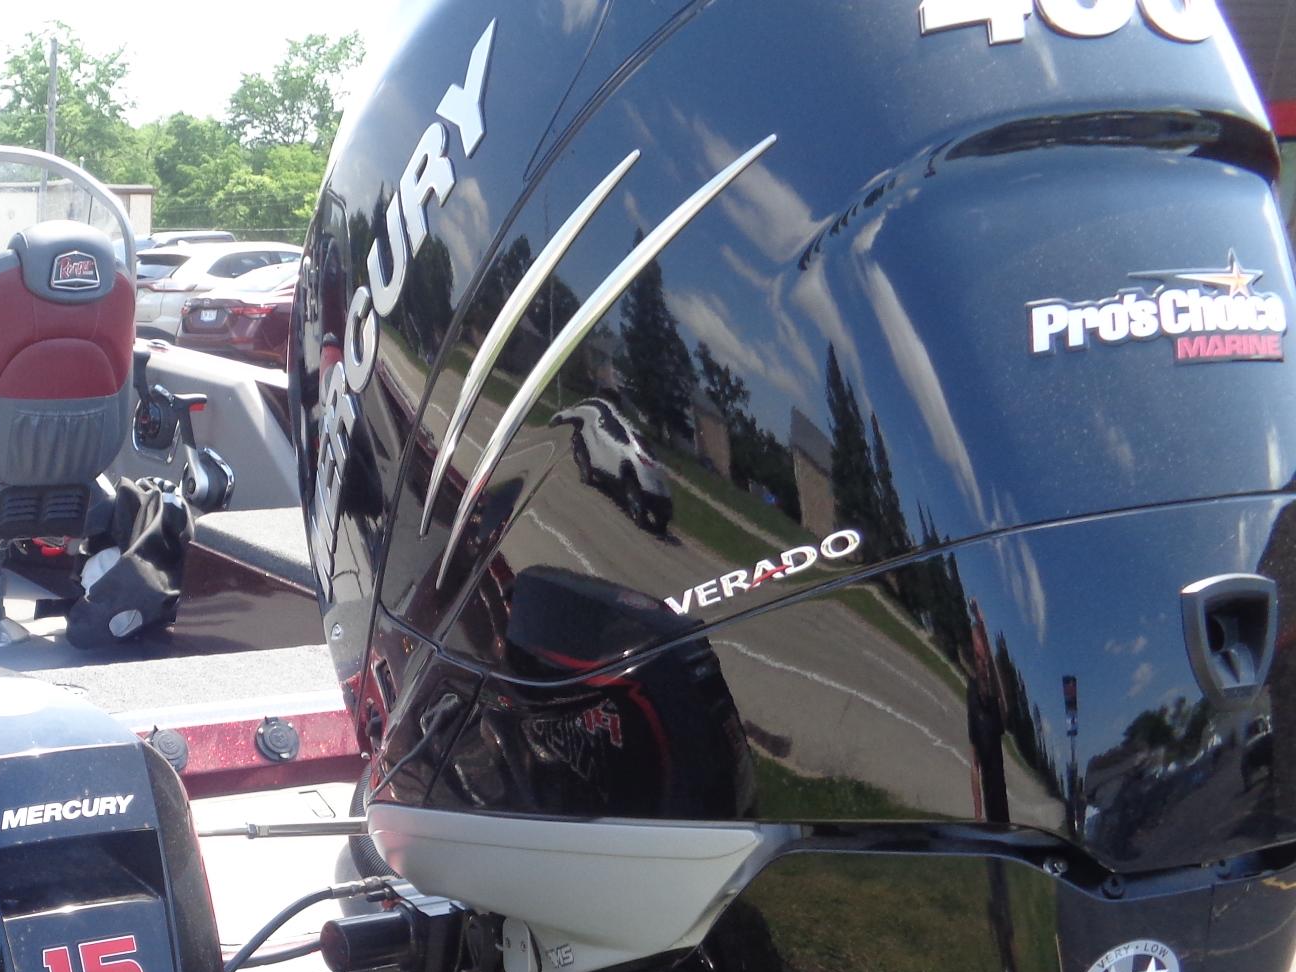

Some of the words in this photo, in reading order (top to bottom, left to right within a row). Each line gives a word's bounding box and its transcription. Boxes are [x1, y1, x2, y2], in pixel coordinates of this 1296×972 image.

[312, 17, 497, 604] MERCURY
[1031, 293, 1159, 353] Pro's
[1158, 287, 1288, 335] Choice
[1176, 334, 1282, 360] MARINE
[663, 529, 861, 616] VERADO
[1, 794, 135, 831] MERCURY
[1144, 942, 1169, 958] LOW
